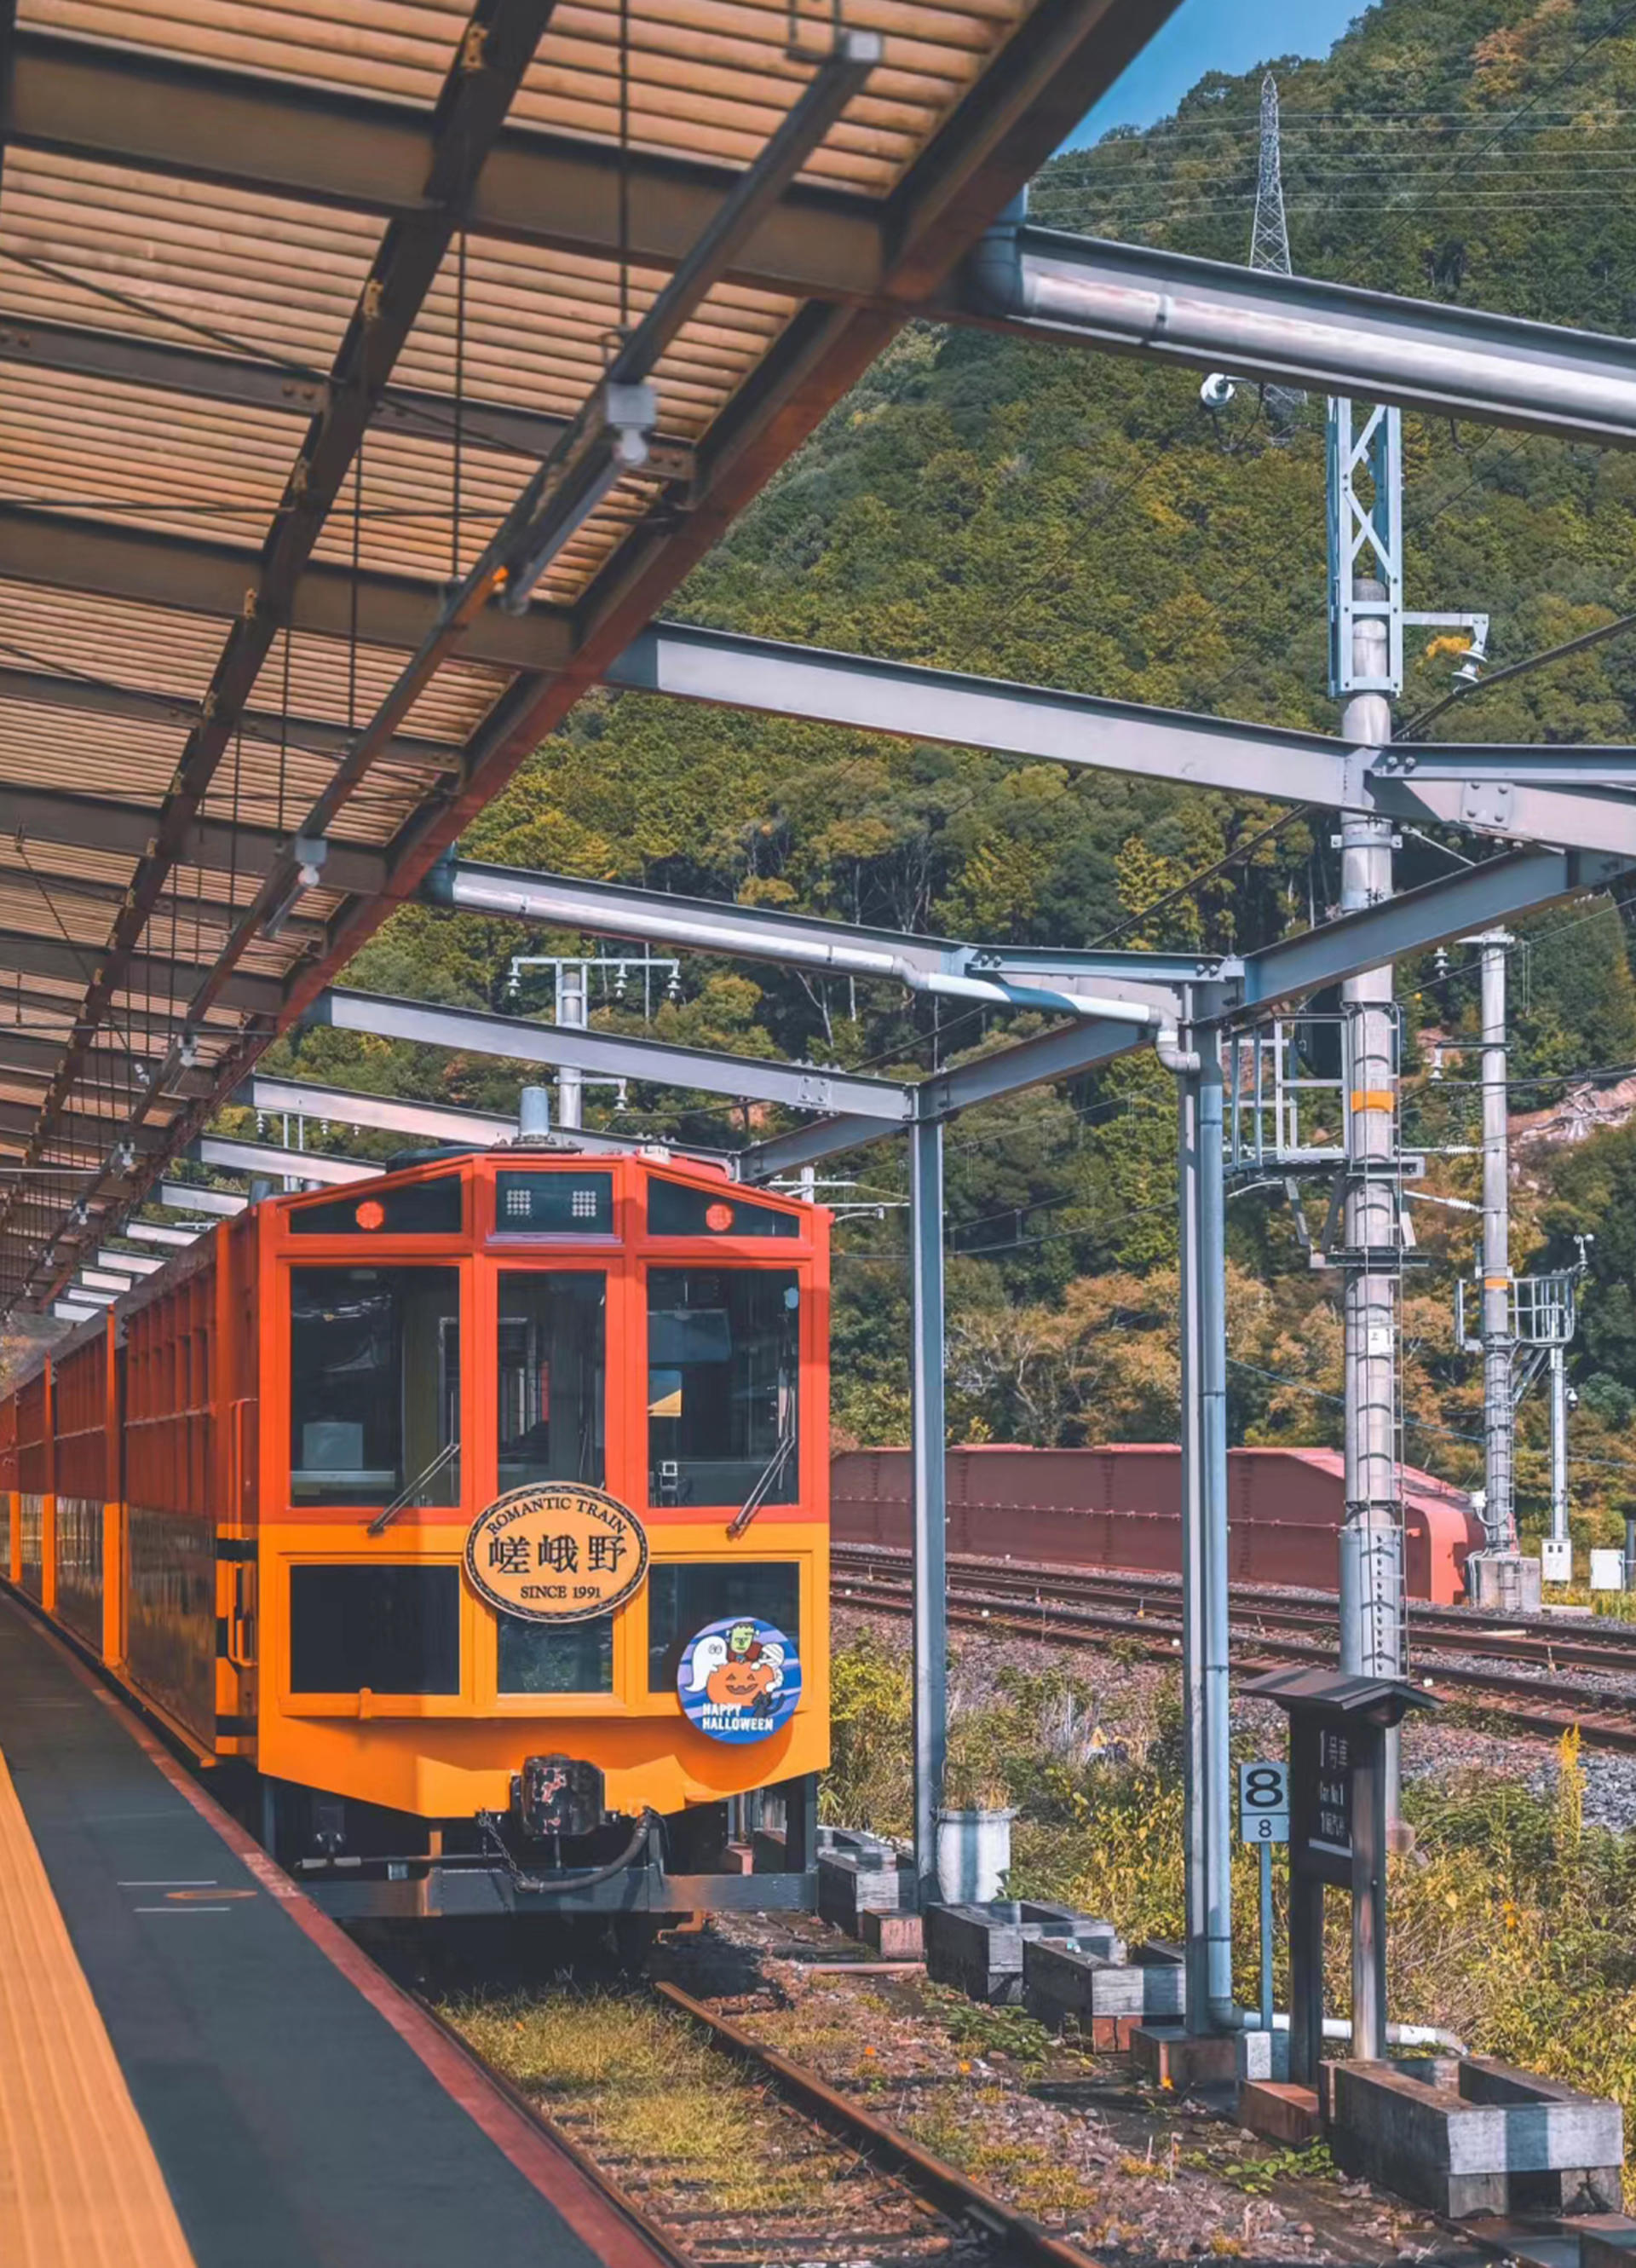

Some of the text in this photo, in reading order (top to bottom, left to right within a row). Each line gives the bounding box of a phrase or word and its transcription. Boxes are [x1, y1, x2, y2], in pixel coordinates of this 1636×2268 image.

[486, 1497, 627, 1535] ROMANTIC TRAIN
[488, 1534, 627, 1574] 嵯峨野
[520, 1585, 601, 1599] SINCE 1991
[702, 1703, 741, 1717] HAPPY
[702, 1717, 774, 1731] HALLOWEEN
[1245, 1768, 1283, 1808] 8
[1259, 1819, 1272, 1838] 8
